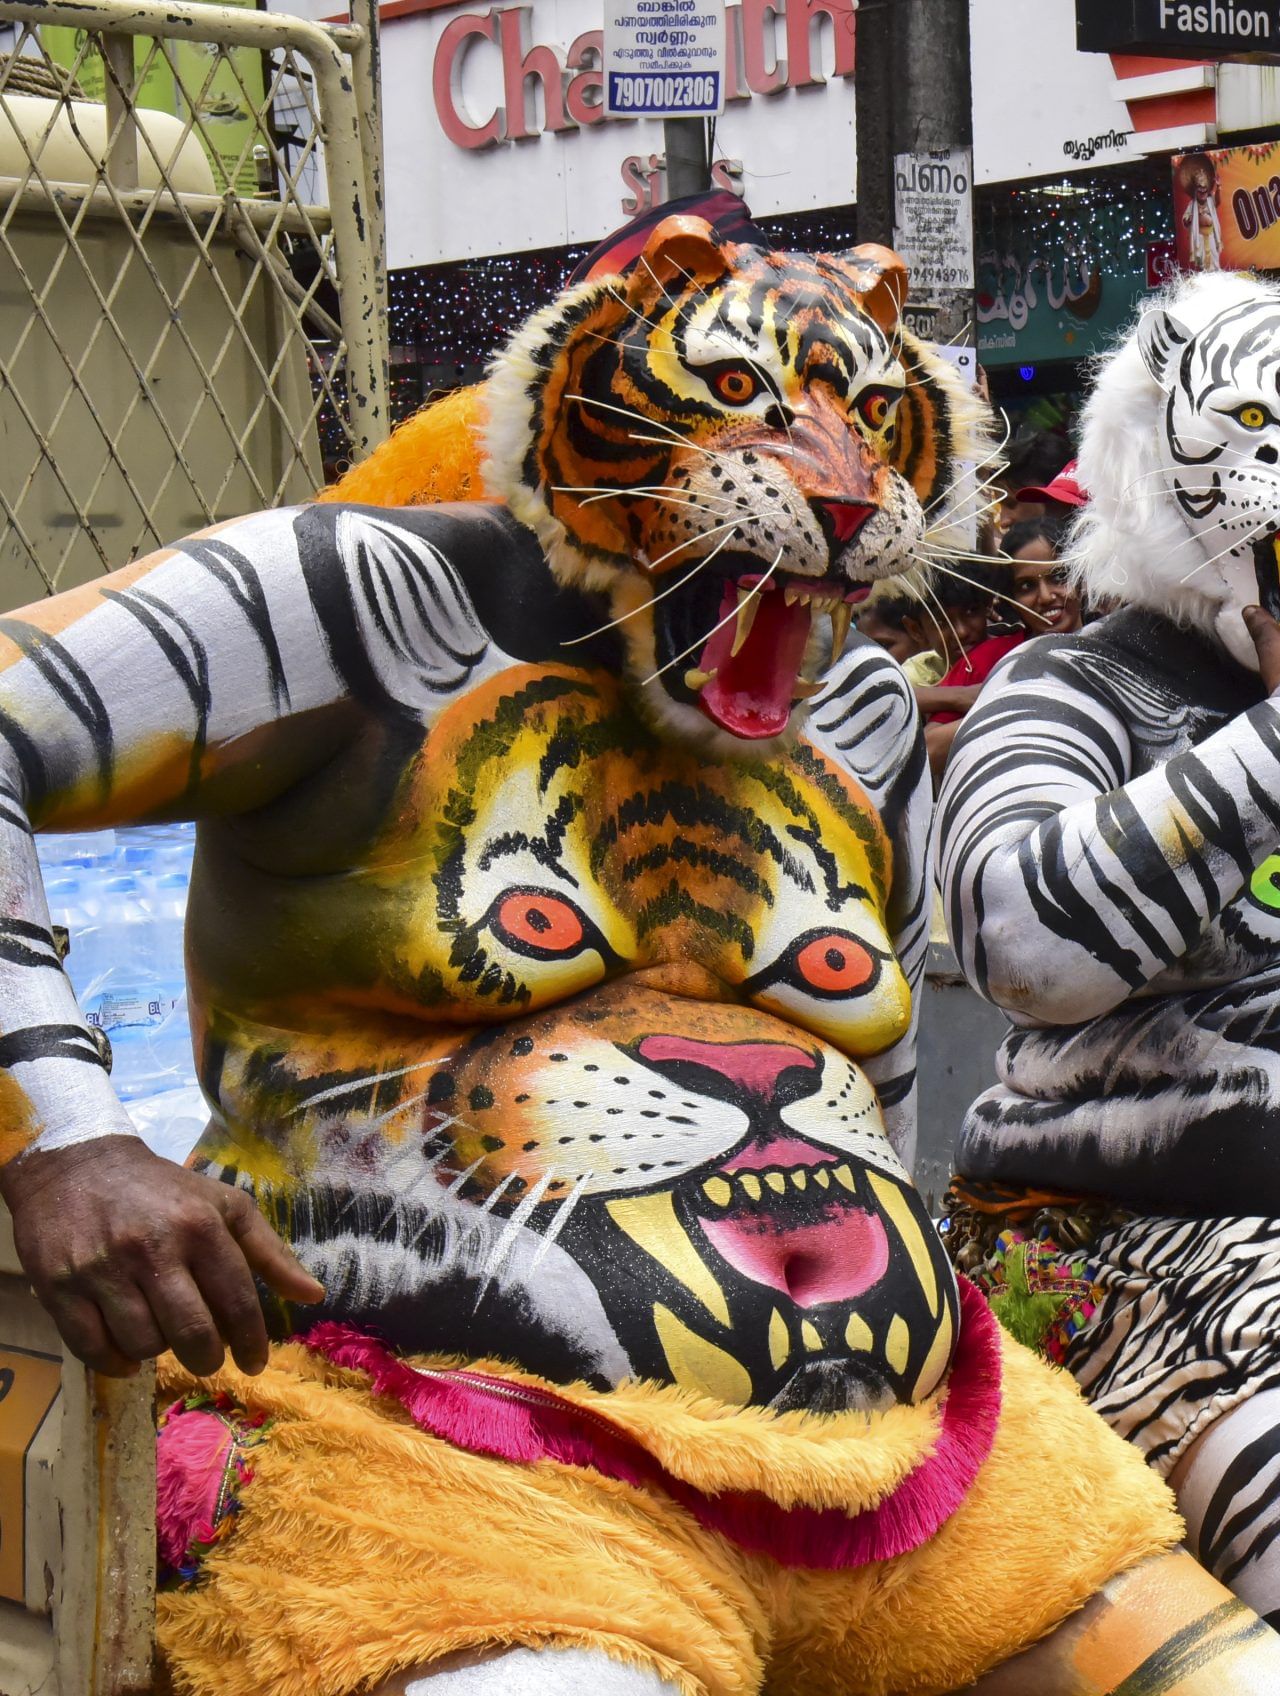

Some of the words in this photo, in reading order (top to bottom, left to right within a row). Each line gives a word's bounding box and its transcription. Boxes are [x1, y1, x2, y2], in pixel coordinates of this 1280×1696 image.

[1160, 0, 1270, 37] Fashion
[614, 76, 715, 107] 7907002306
[896, 163, 968, 195] പണം
